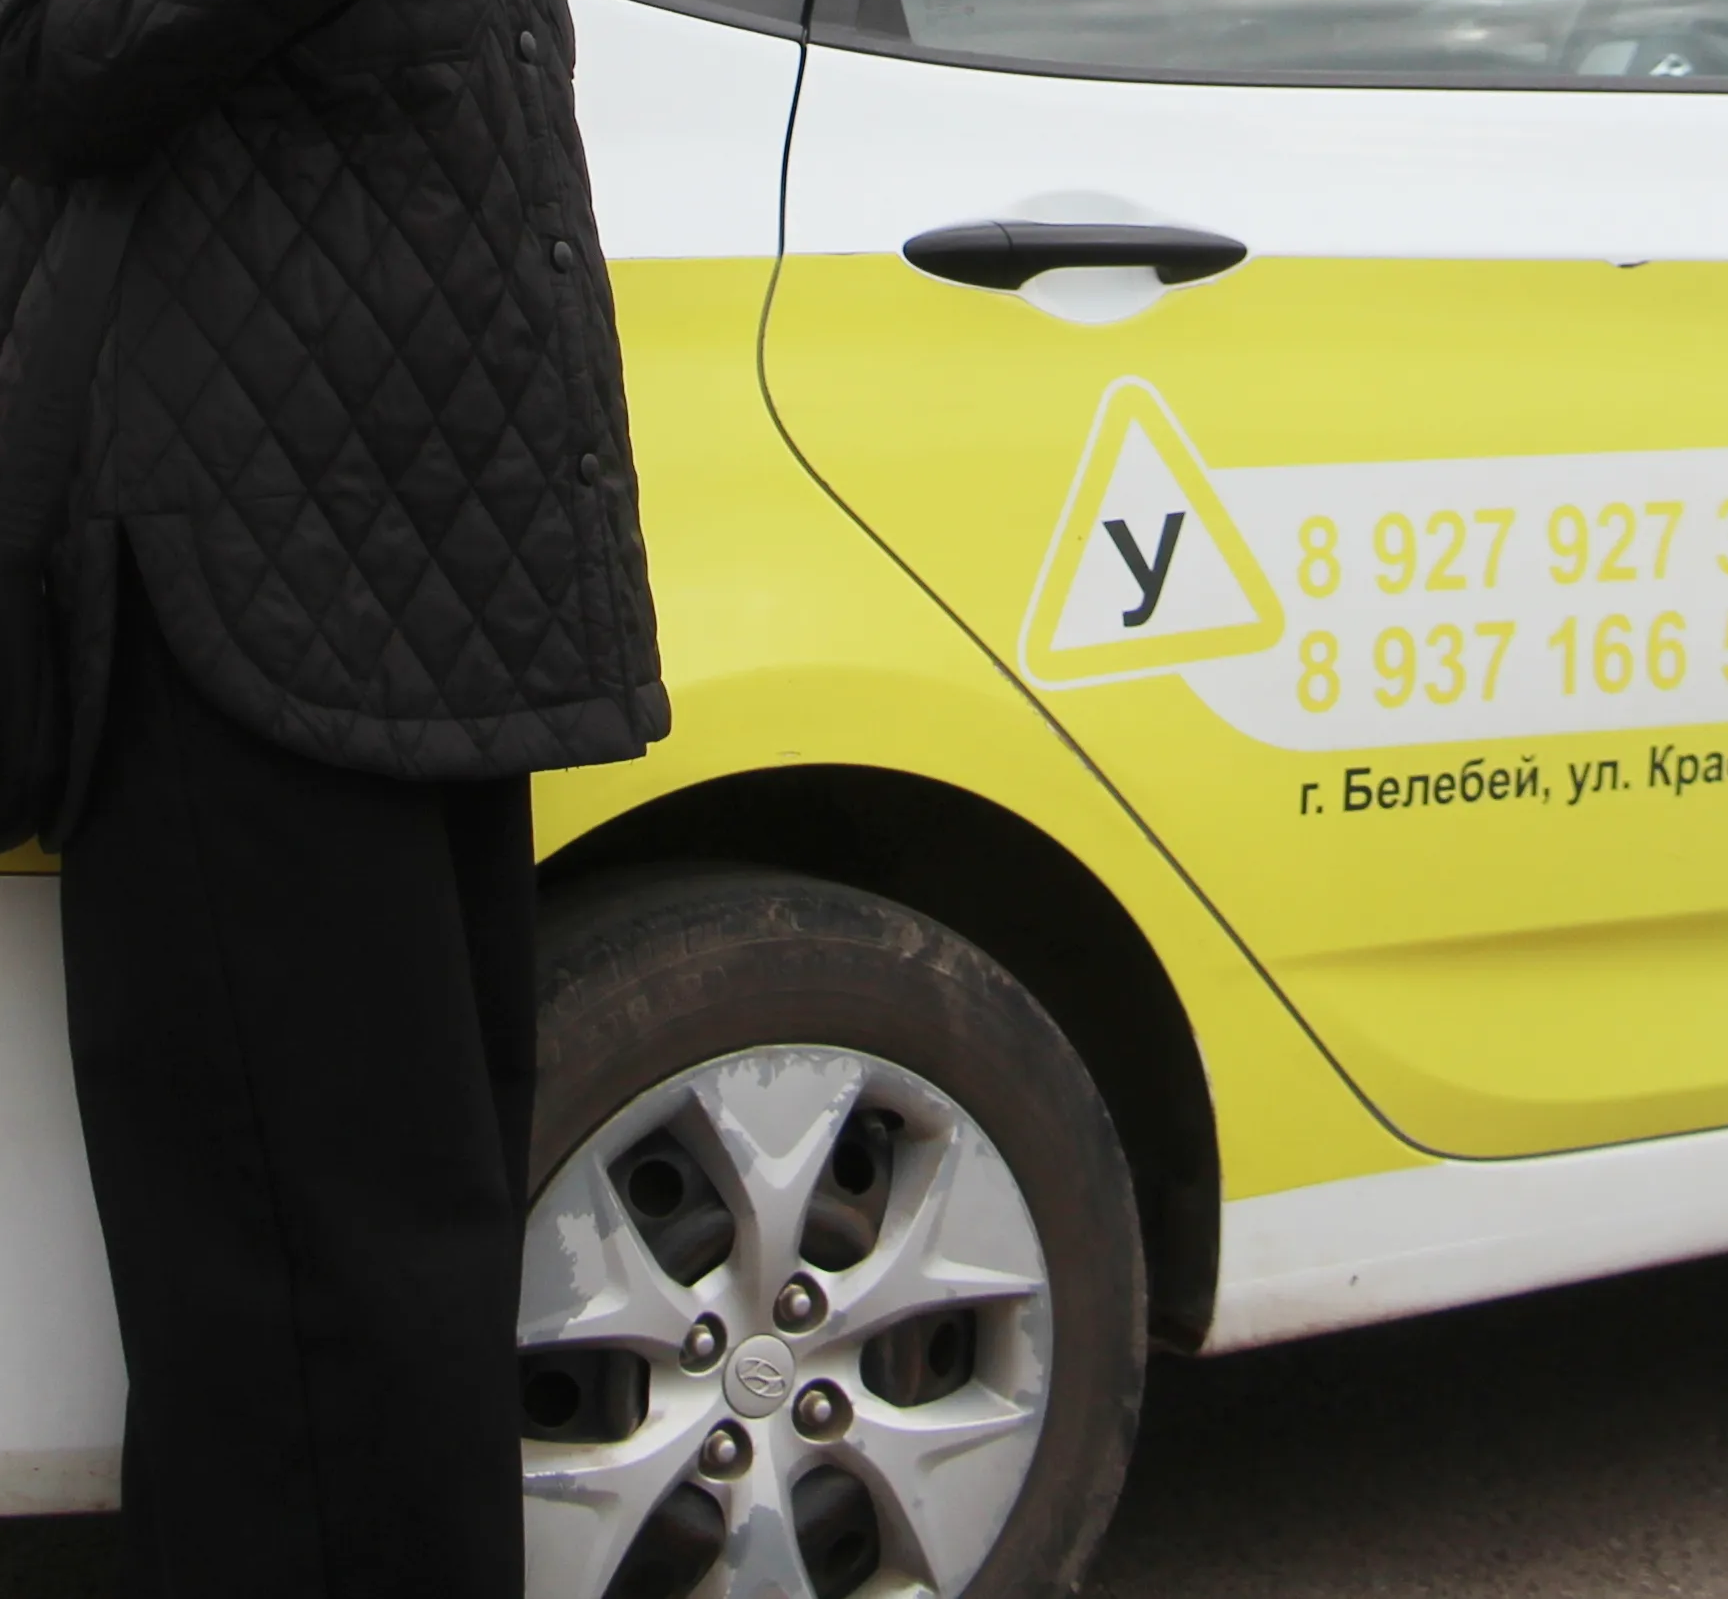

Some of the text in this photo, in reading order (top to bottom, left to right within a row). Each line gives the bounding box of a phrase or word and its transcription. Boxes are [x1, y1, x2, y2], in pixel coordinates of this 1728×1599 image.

[1101, 510, 1187, 629] У
[1296, 514, 1342, 600] 8
[1372, 507, 1517, 596] 927
[1546, 499, 1686, 587] 927
[1296, 628, 1342, 715] 8
[1372, 619, 1518, 710] 937
[1547, 609, 1688, 697] 166
[1299, 782, 1326, 816] г.
[1342, 754, 1552, 813] Белебей,
[1566, 760, 1631, 807] ул.
